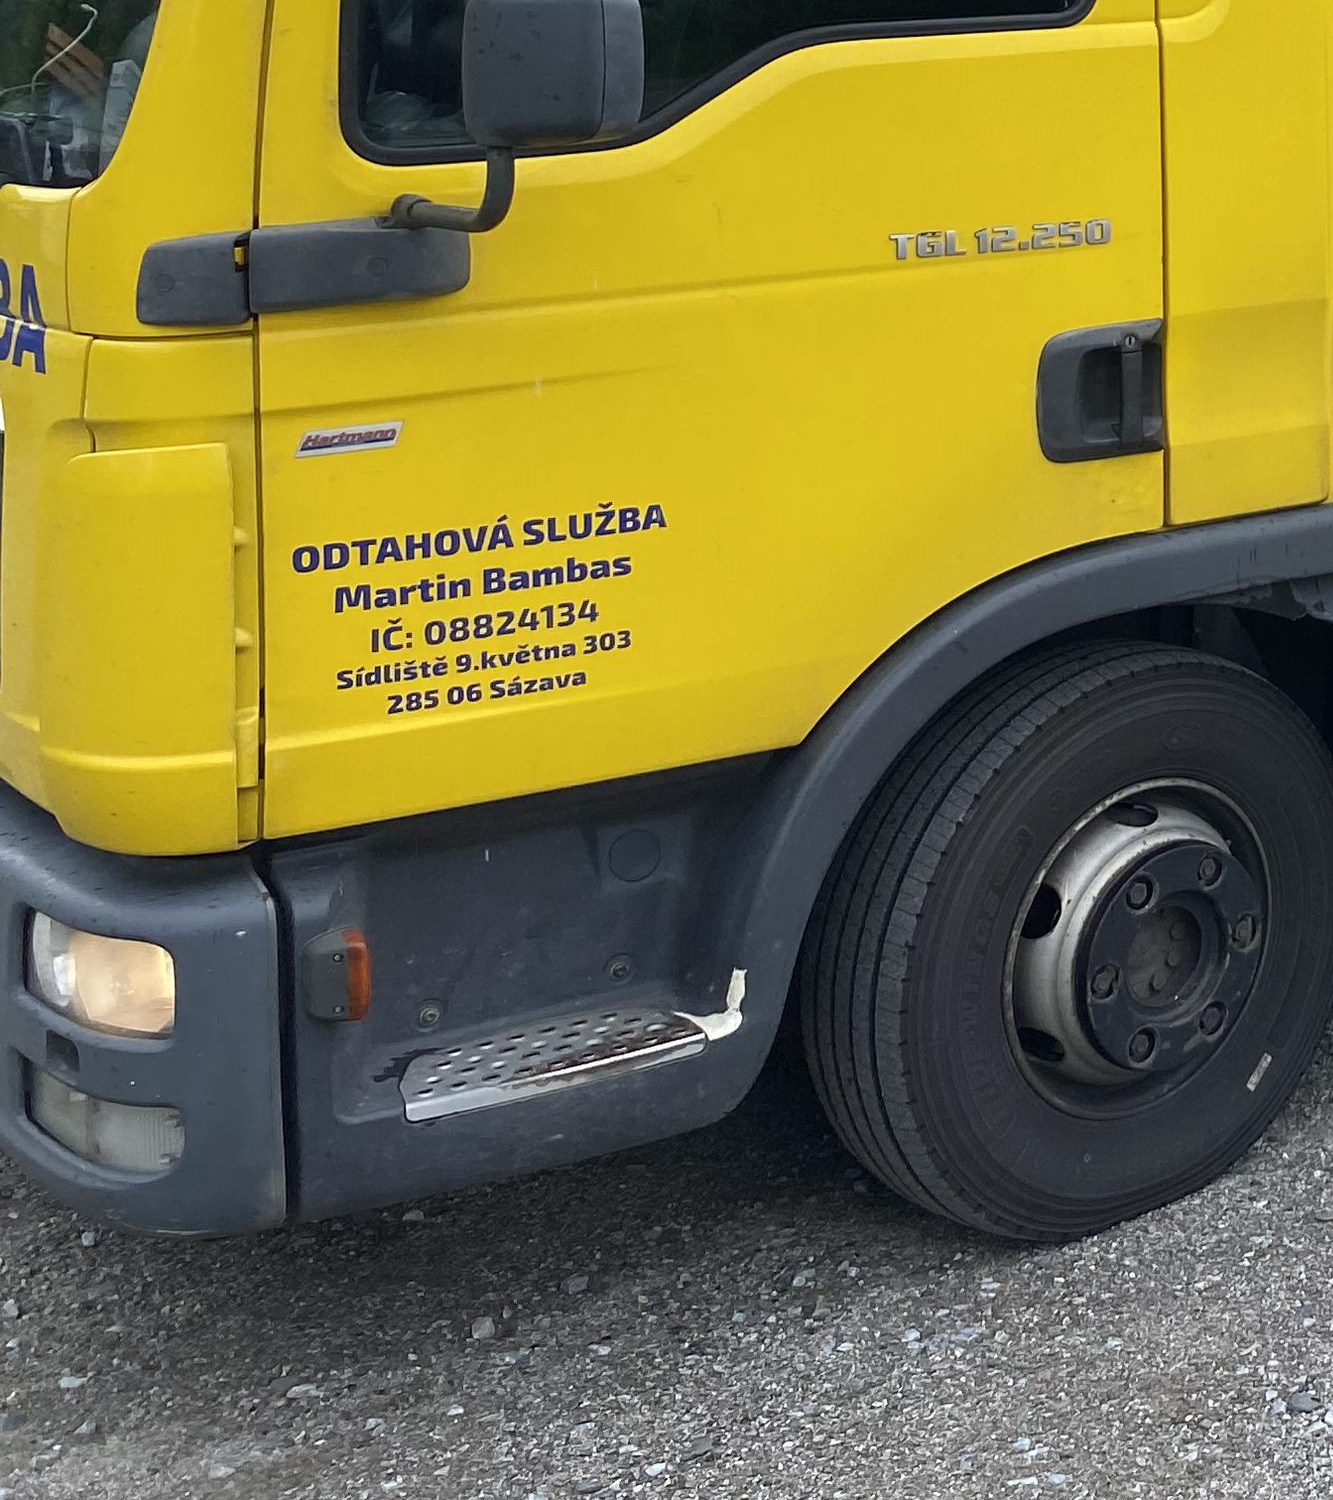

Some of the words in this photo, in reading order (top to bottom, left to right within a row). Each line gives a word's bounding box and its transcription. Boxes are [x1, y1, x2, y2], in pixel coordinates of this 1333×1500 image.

[889, 230, 967, 260] TGL
[974, 219, 1111, 254] 12.250
[292, 515, 514, 573] ODTAHOVÁ
[523, 502, 667, 546] SLUŽBA
[335, 574, 471, 613] Martin
[483, 556, 632, 594] Bambas
[371, 617, 413, 652] IČ:
[425, 599, 599, 645] 08824134
[337, 659, 448, 690] Sídliště
[455, 642, 576, 673] 9.května
[584, 630, 632, 655] 303
[387, 689, 439, 714] 285
[447, 683, 482, 705] 06
[490, 672, 587, 699] Sázava
